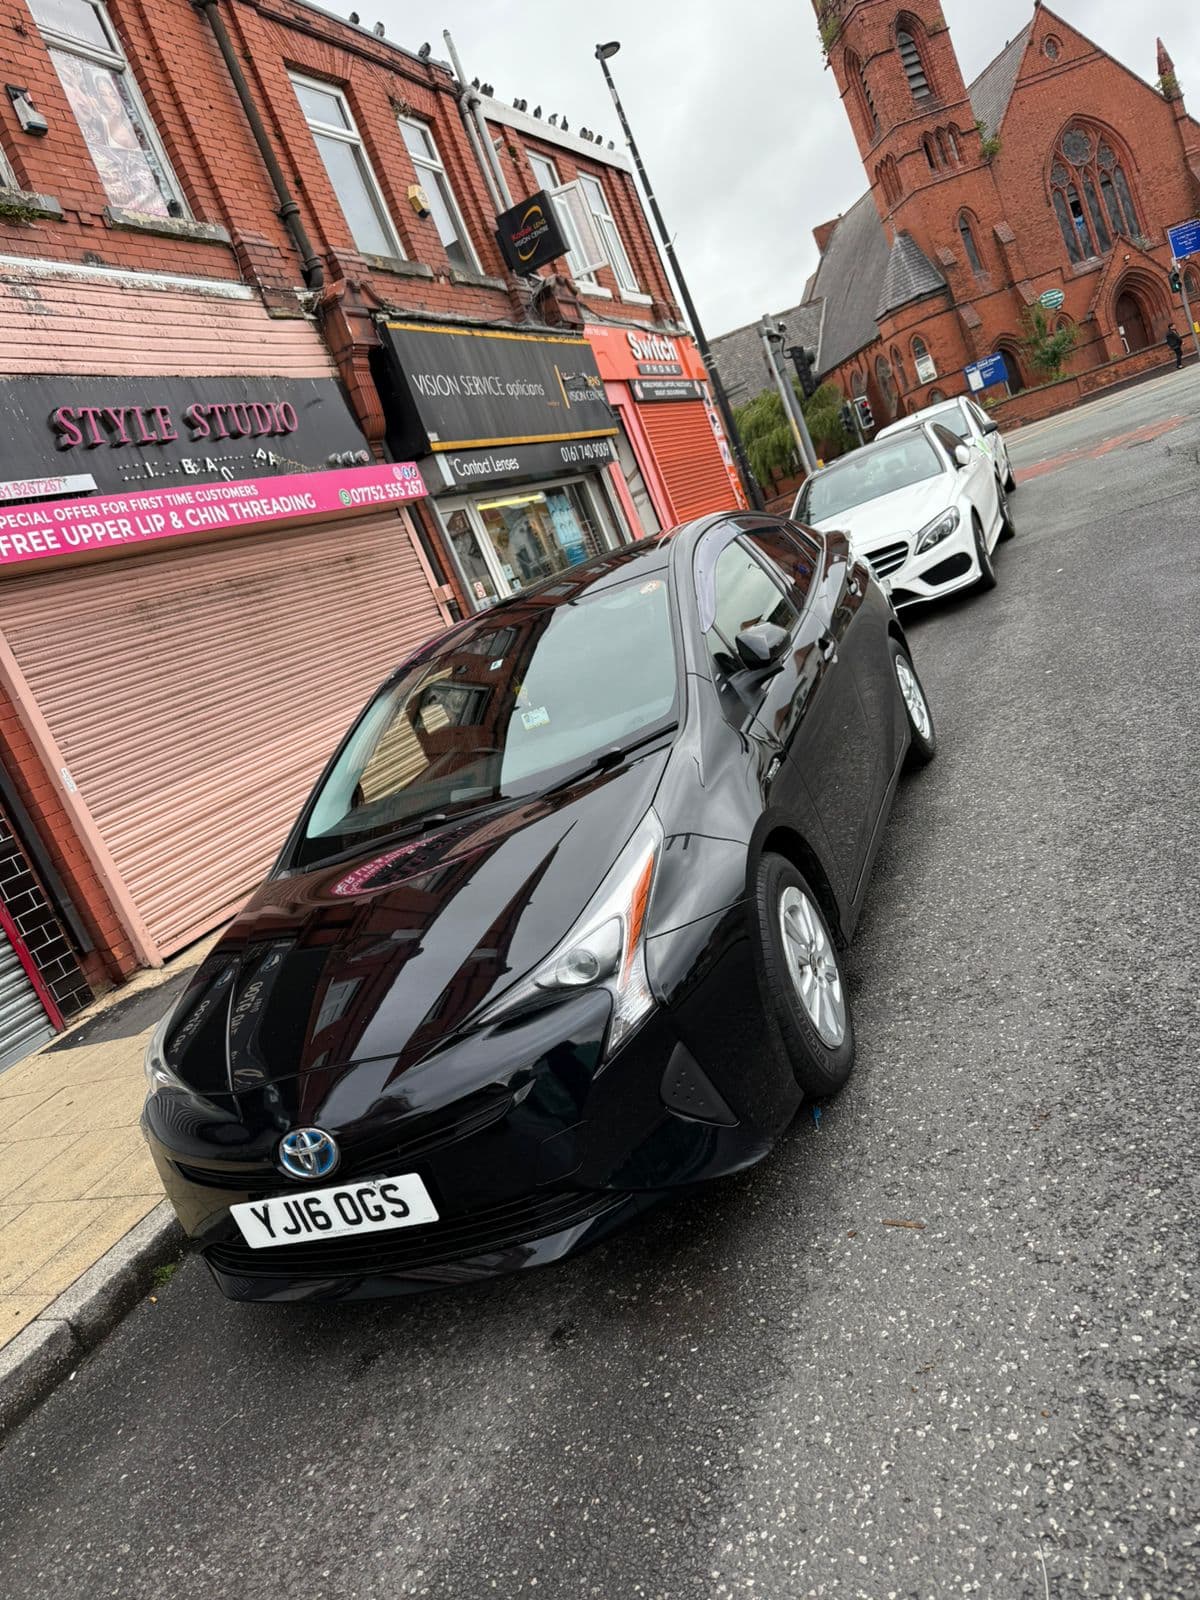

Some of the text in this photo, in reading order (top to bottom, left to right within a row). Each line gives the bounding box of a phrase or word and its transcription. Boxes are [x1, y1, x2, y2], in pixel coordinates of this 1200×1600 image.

[627, 332, 678, 361] Switch
[646, 365, 677, 373] PHONE
[412, 374, 544, 398] VISION SERVICE opticians
[54, 401, 299, 446] STYLE STUDIO
[560, 442, 609, 463] 0161 740 9009
[454, 456, 520, 477] Contact Lenses
[12, 480, 62, 496] 5267267
[351, 480, 424, 504] 07752 555 267
[54, 502, 102, 522] OFFER
[101, 500, 130, 516] FOR
[130, 496, 165, 512] FIRST
[165, 492, 195, 506] TIME
[195, 484, 259, 503] CUSTOMERS
[0, 493, 316, 557] FREE UPPER LIP & CHIN THREADING
[250, 1184, 410, 1238] YJ16 OGS
